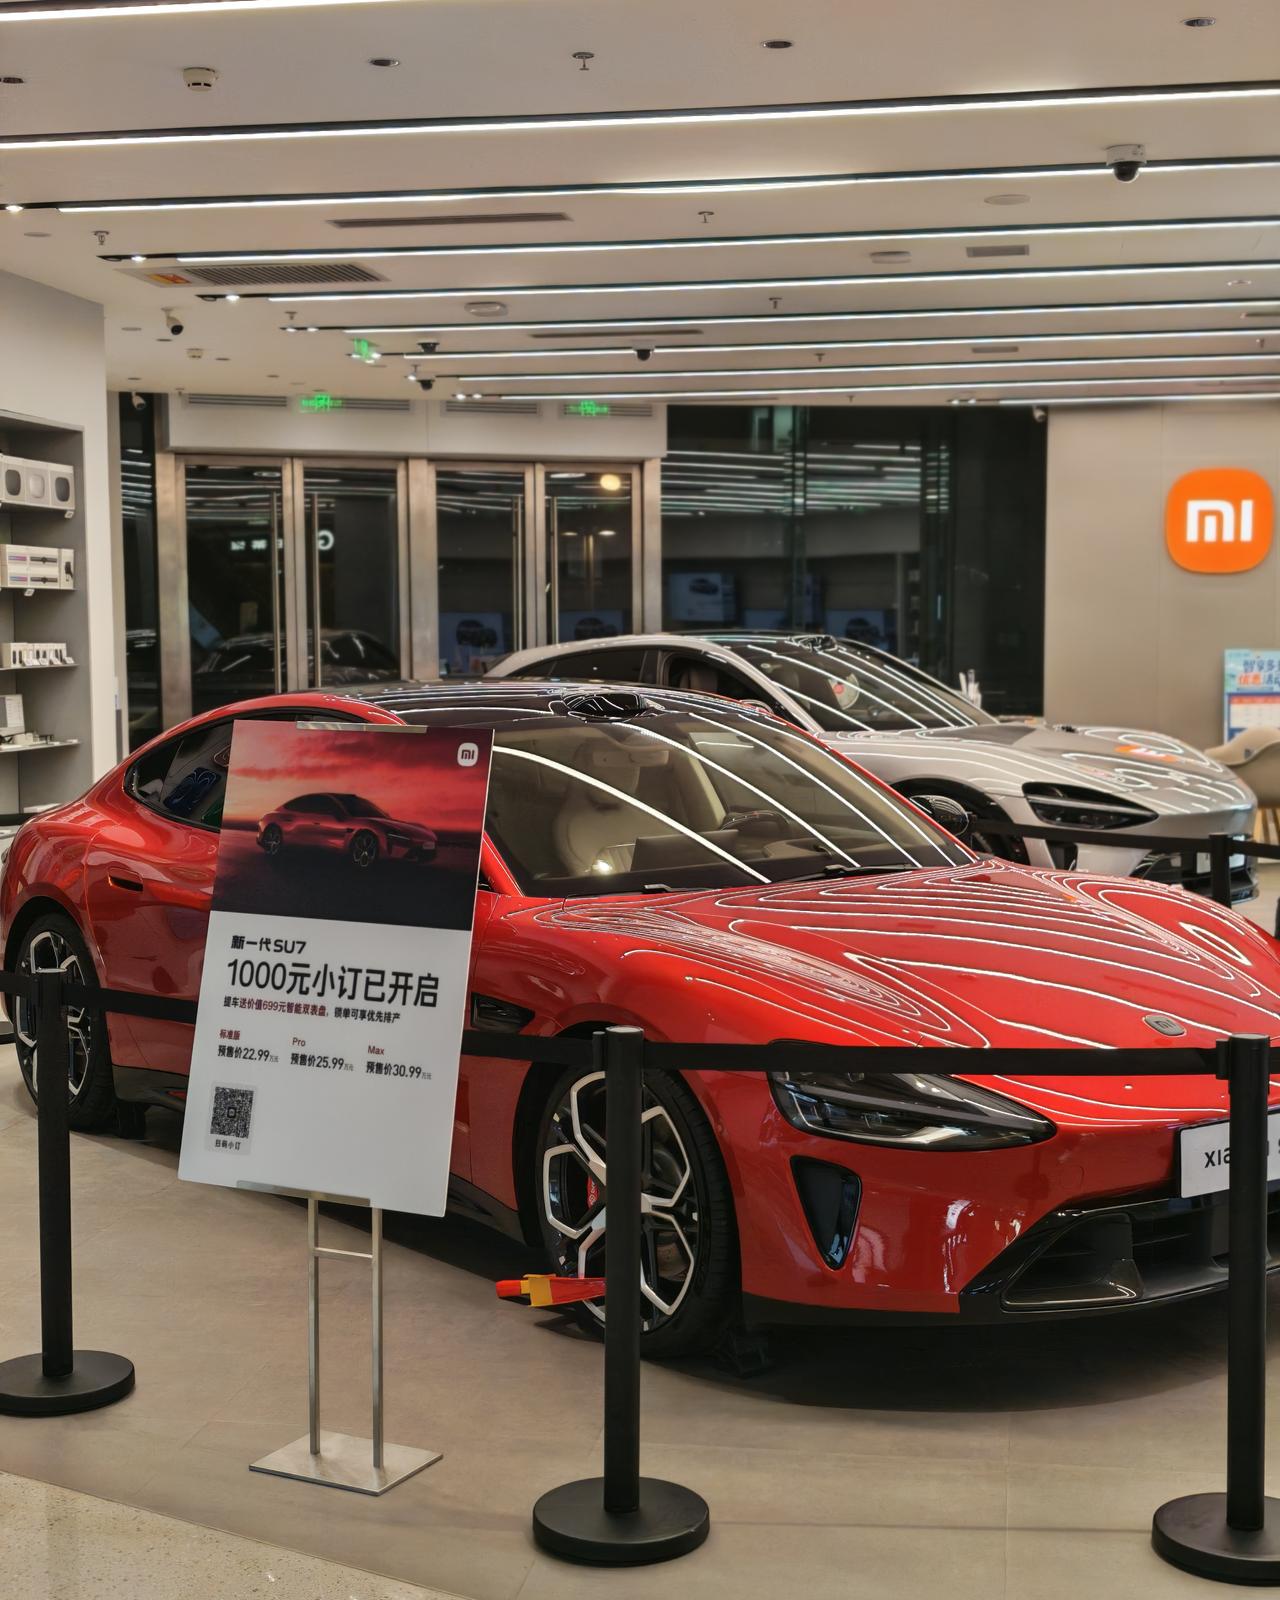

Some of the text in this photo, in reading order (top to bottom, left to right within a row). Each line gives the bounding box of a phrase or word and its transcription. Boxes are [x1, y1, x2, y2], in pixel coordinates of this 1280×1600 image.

[231, 935, 307, 955] 新一代SU7
[227, 958, 440, 1008] 1000元小订已开启
[219, 1029, 241, 1041] 标准版
[292, 1037, 306, 1048] Pro
[367, 1045, 385, 1056] Max
